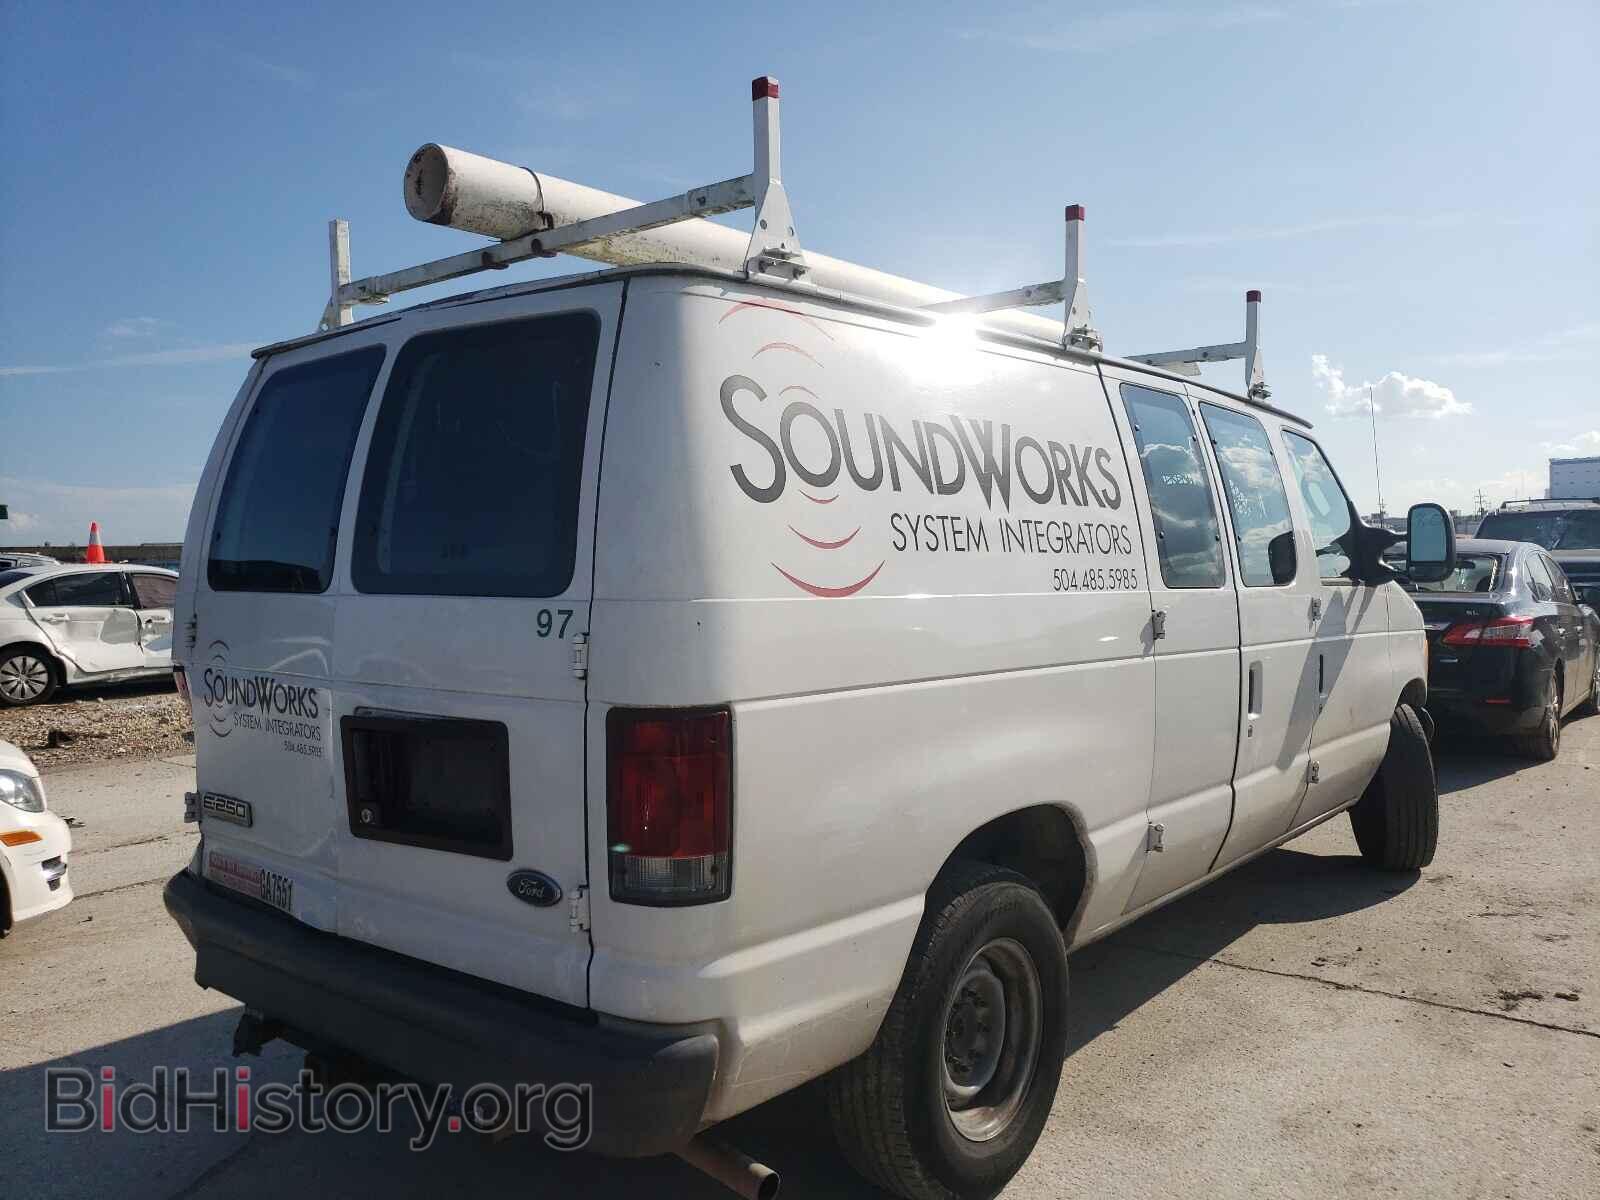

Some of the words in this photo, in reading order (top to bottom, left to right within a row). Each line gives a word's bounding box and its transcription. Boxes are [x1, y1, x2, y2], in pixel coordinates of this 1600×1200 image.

[719, 374, 1121, 512] SOUNDWORKS
[890, 513, 989, 552] SYSTEM
[999, 517, 1132, 555] INTEGRATORS
[1053, 568, 1138, 591] 504.485.5985
[536, 608, 574, 639] 97
[203, 667, 319, 719] SOUNDWORKS
[234, 711, 262, 729] SYSTEM
[265, 718, 321, 741] INTEGRATORS
[519, 879, 544, 898] Ford
